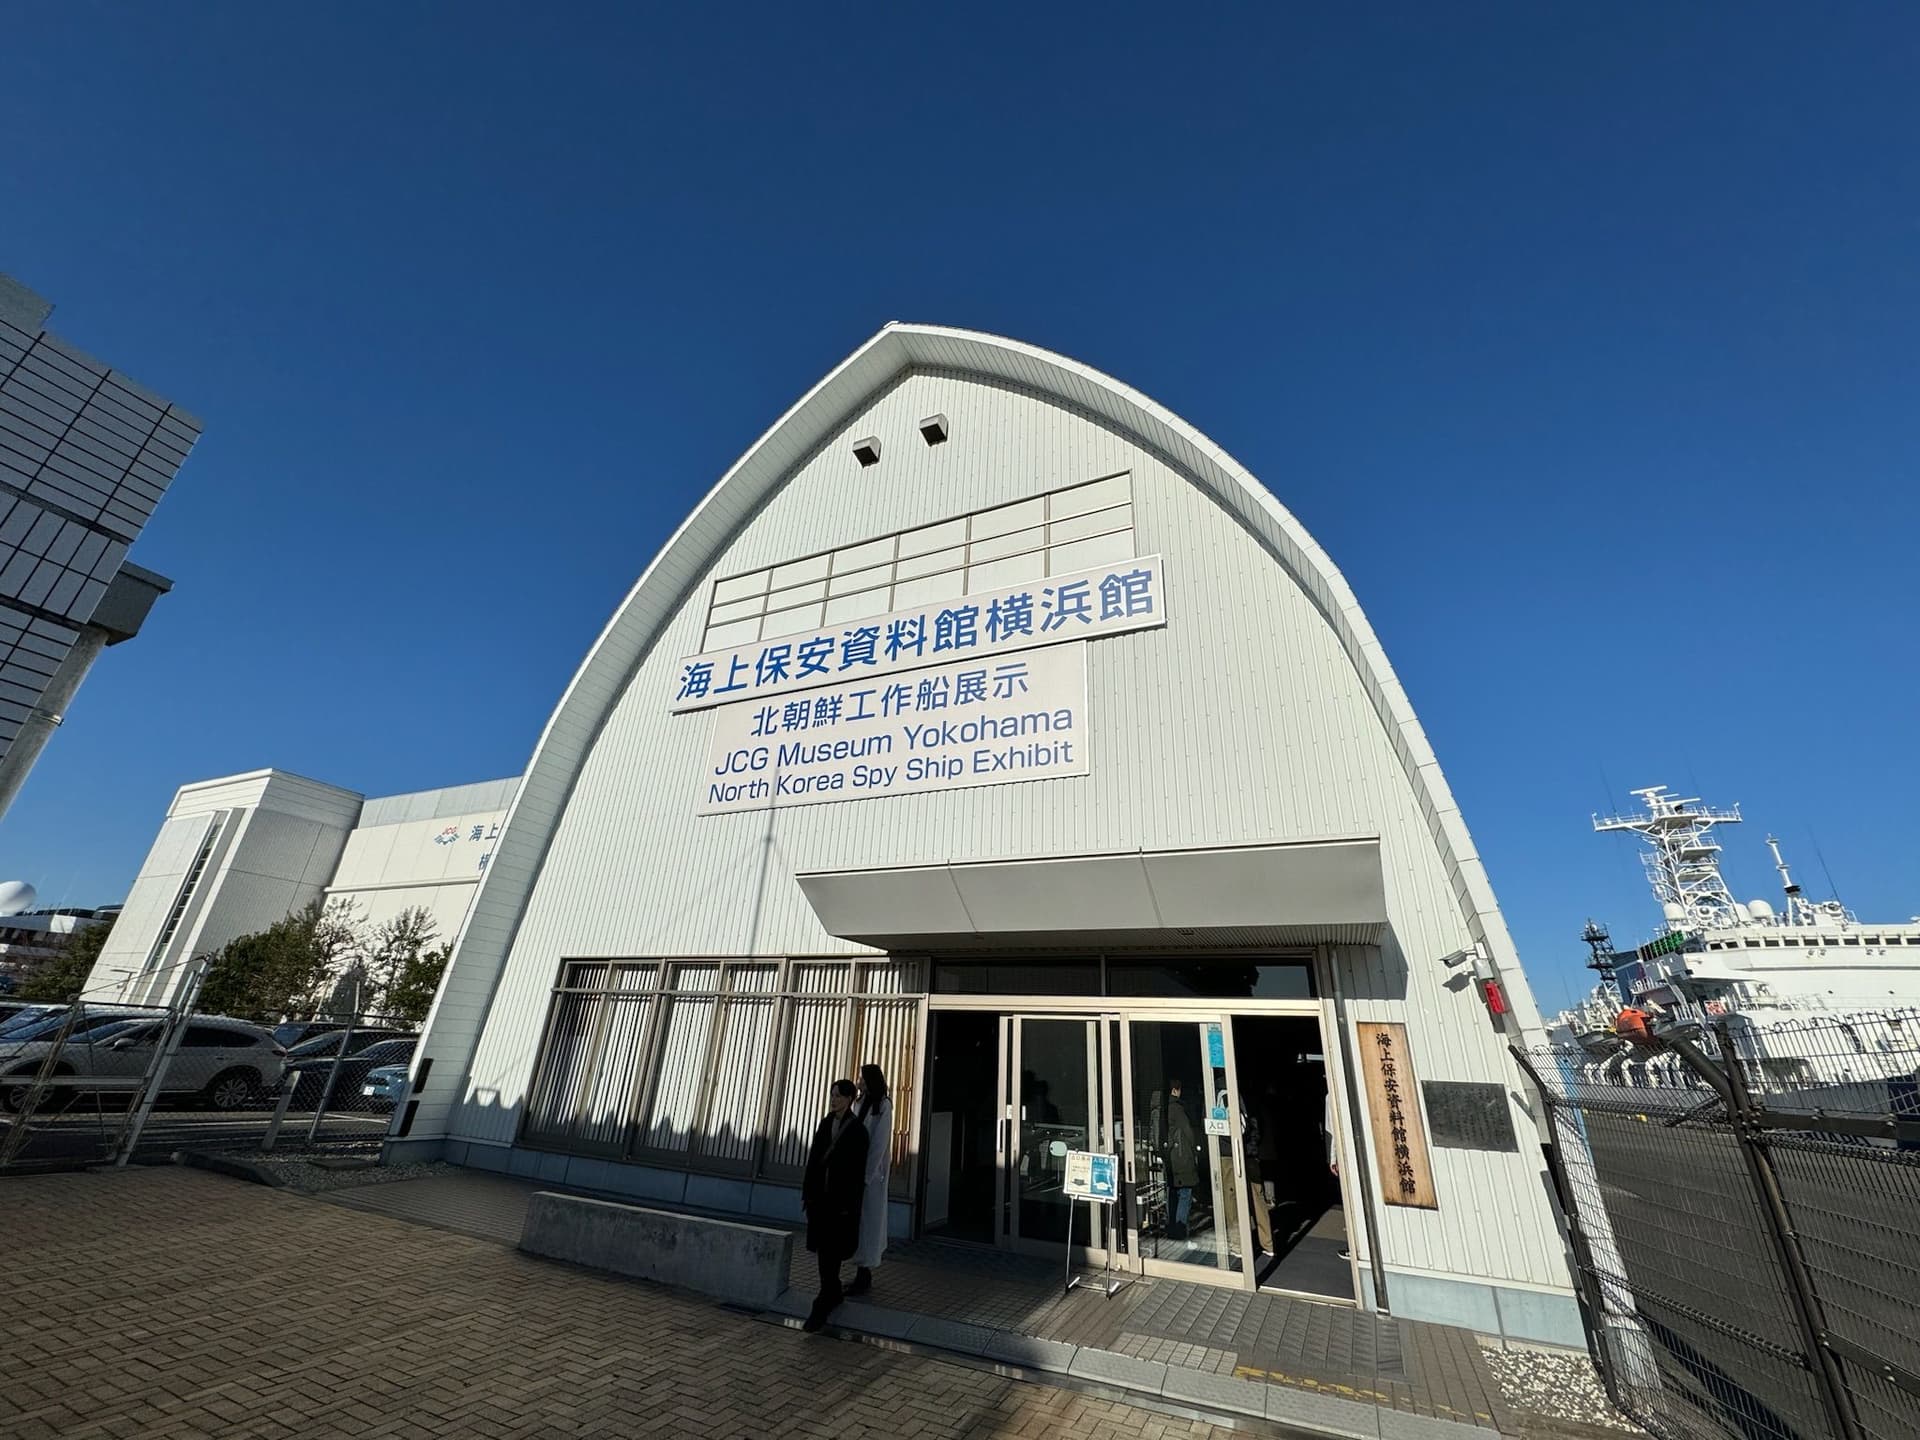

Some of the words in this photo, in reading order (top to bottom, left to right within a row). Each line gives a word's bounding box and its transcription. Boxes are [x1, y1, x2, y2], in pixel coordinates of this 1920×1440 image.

[676, 569, 1153, 701] 海上保安資料館横浜館
[751, 662, 1029, 737] 北朝鮮工作船展示
[709, 778, 769, 803] North
[776, 772, 844, 796] Korea
[852, 765, 898, 788] Spy
[906, 755, 964, 779] Ship
[973, 741, 1074, 774] Exhibit
[715, 747, 769, 775] JCG
[777, 733, 892, 768] Museum
[903, 708, 1073, 750] Yokohama
[1208, 1121, 1224, 1130] 入口
[1375, 1032, 1416, 1195] 海上保安資料館横浜館
